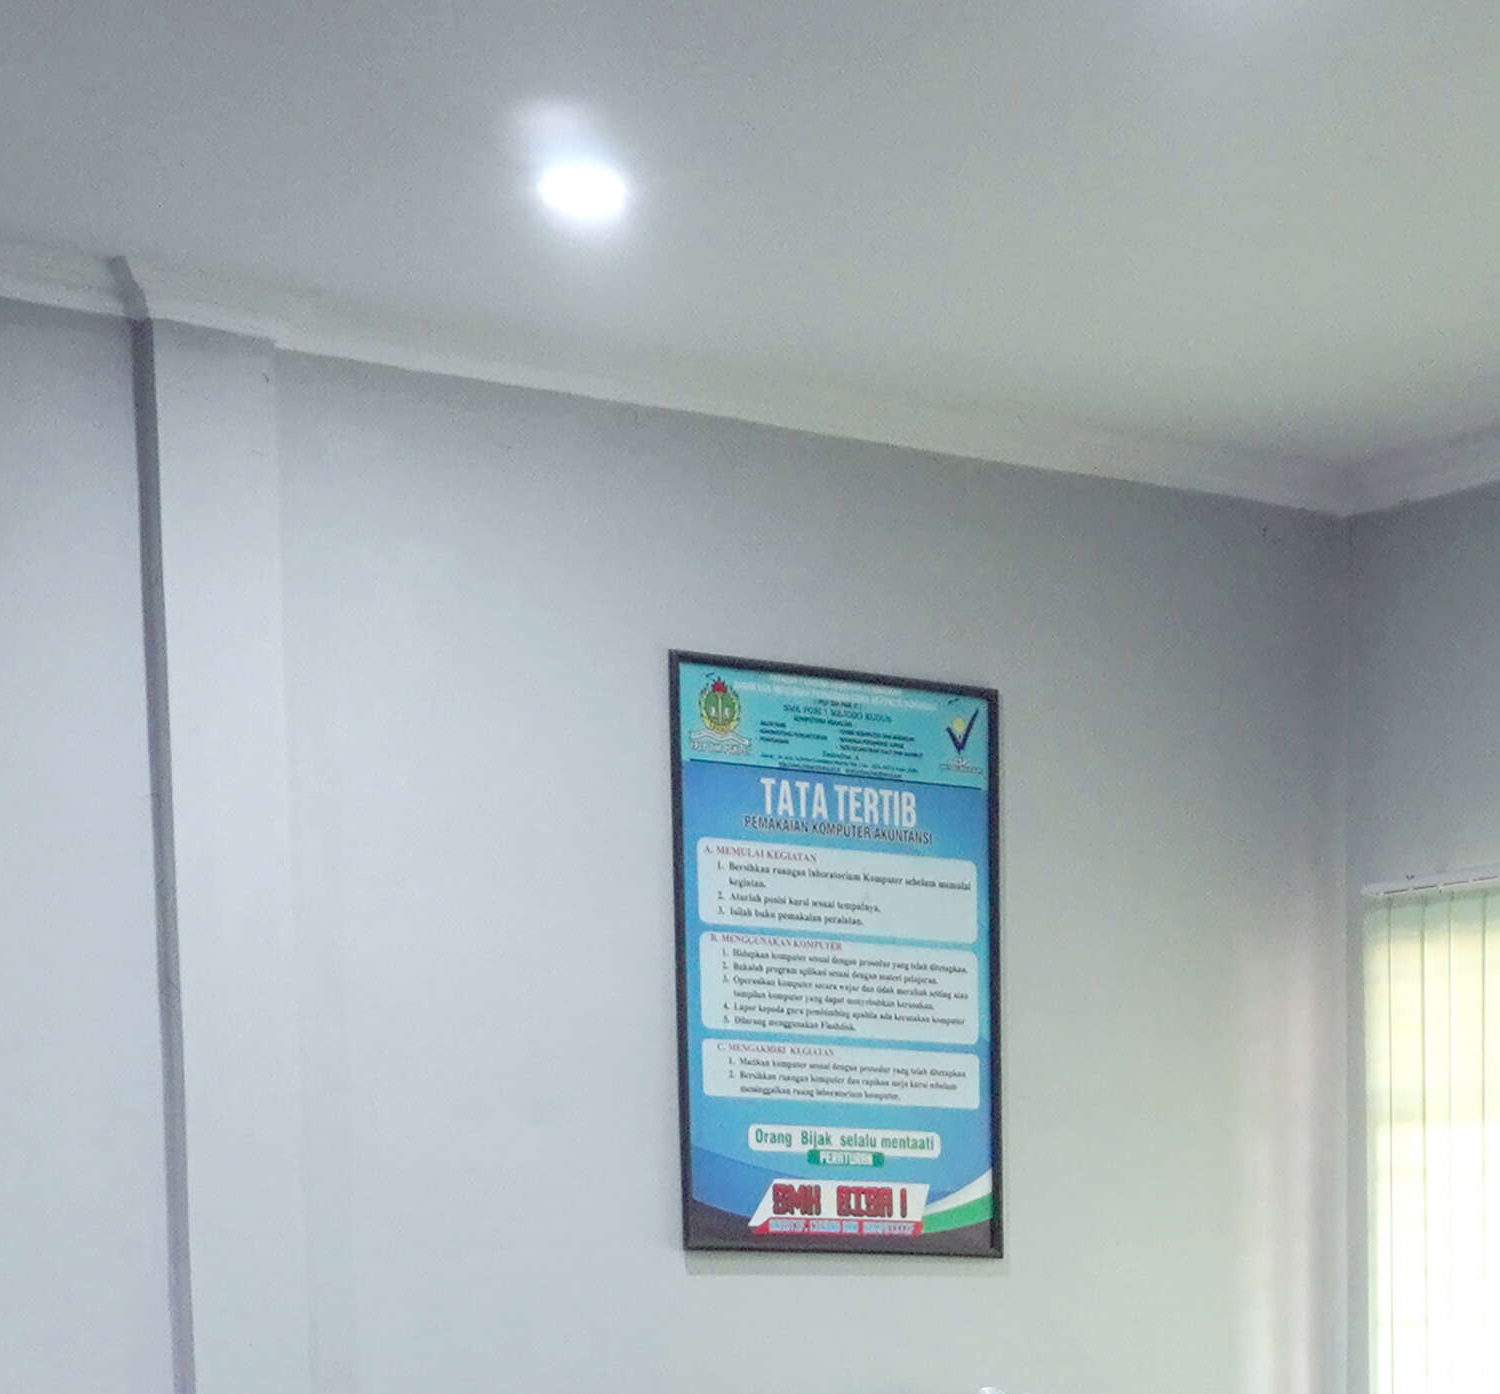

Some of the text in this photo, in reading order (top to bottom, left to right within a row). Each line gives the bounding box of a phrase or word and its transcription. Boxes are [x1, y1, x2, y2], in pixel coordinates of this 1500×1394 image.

[760, 777, 917, 827] TATA TERTIB
[744, 815, 932, 844] PEMAKAIAN KOMPUTER AKUNTANSI
[755, 1128, 934, 1150] Orang Bijak selalu mentaati
